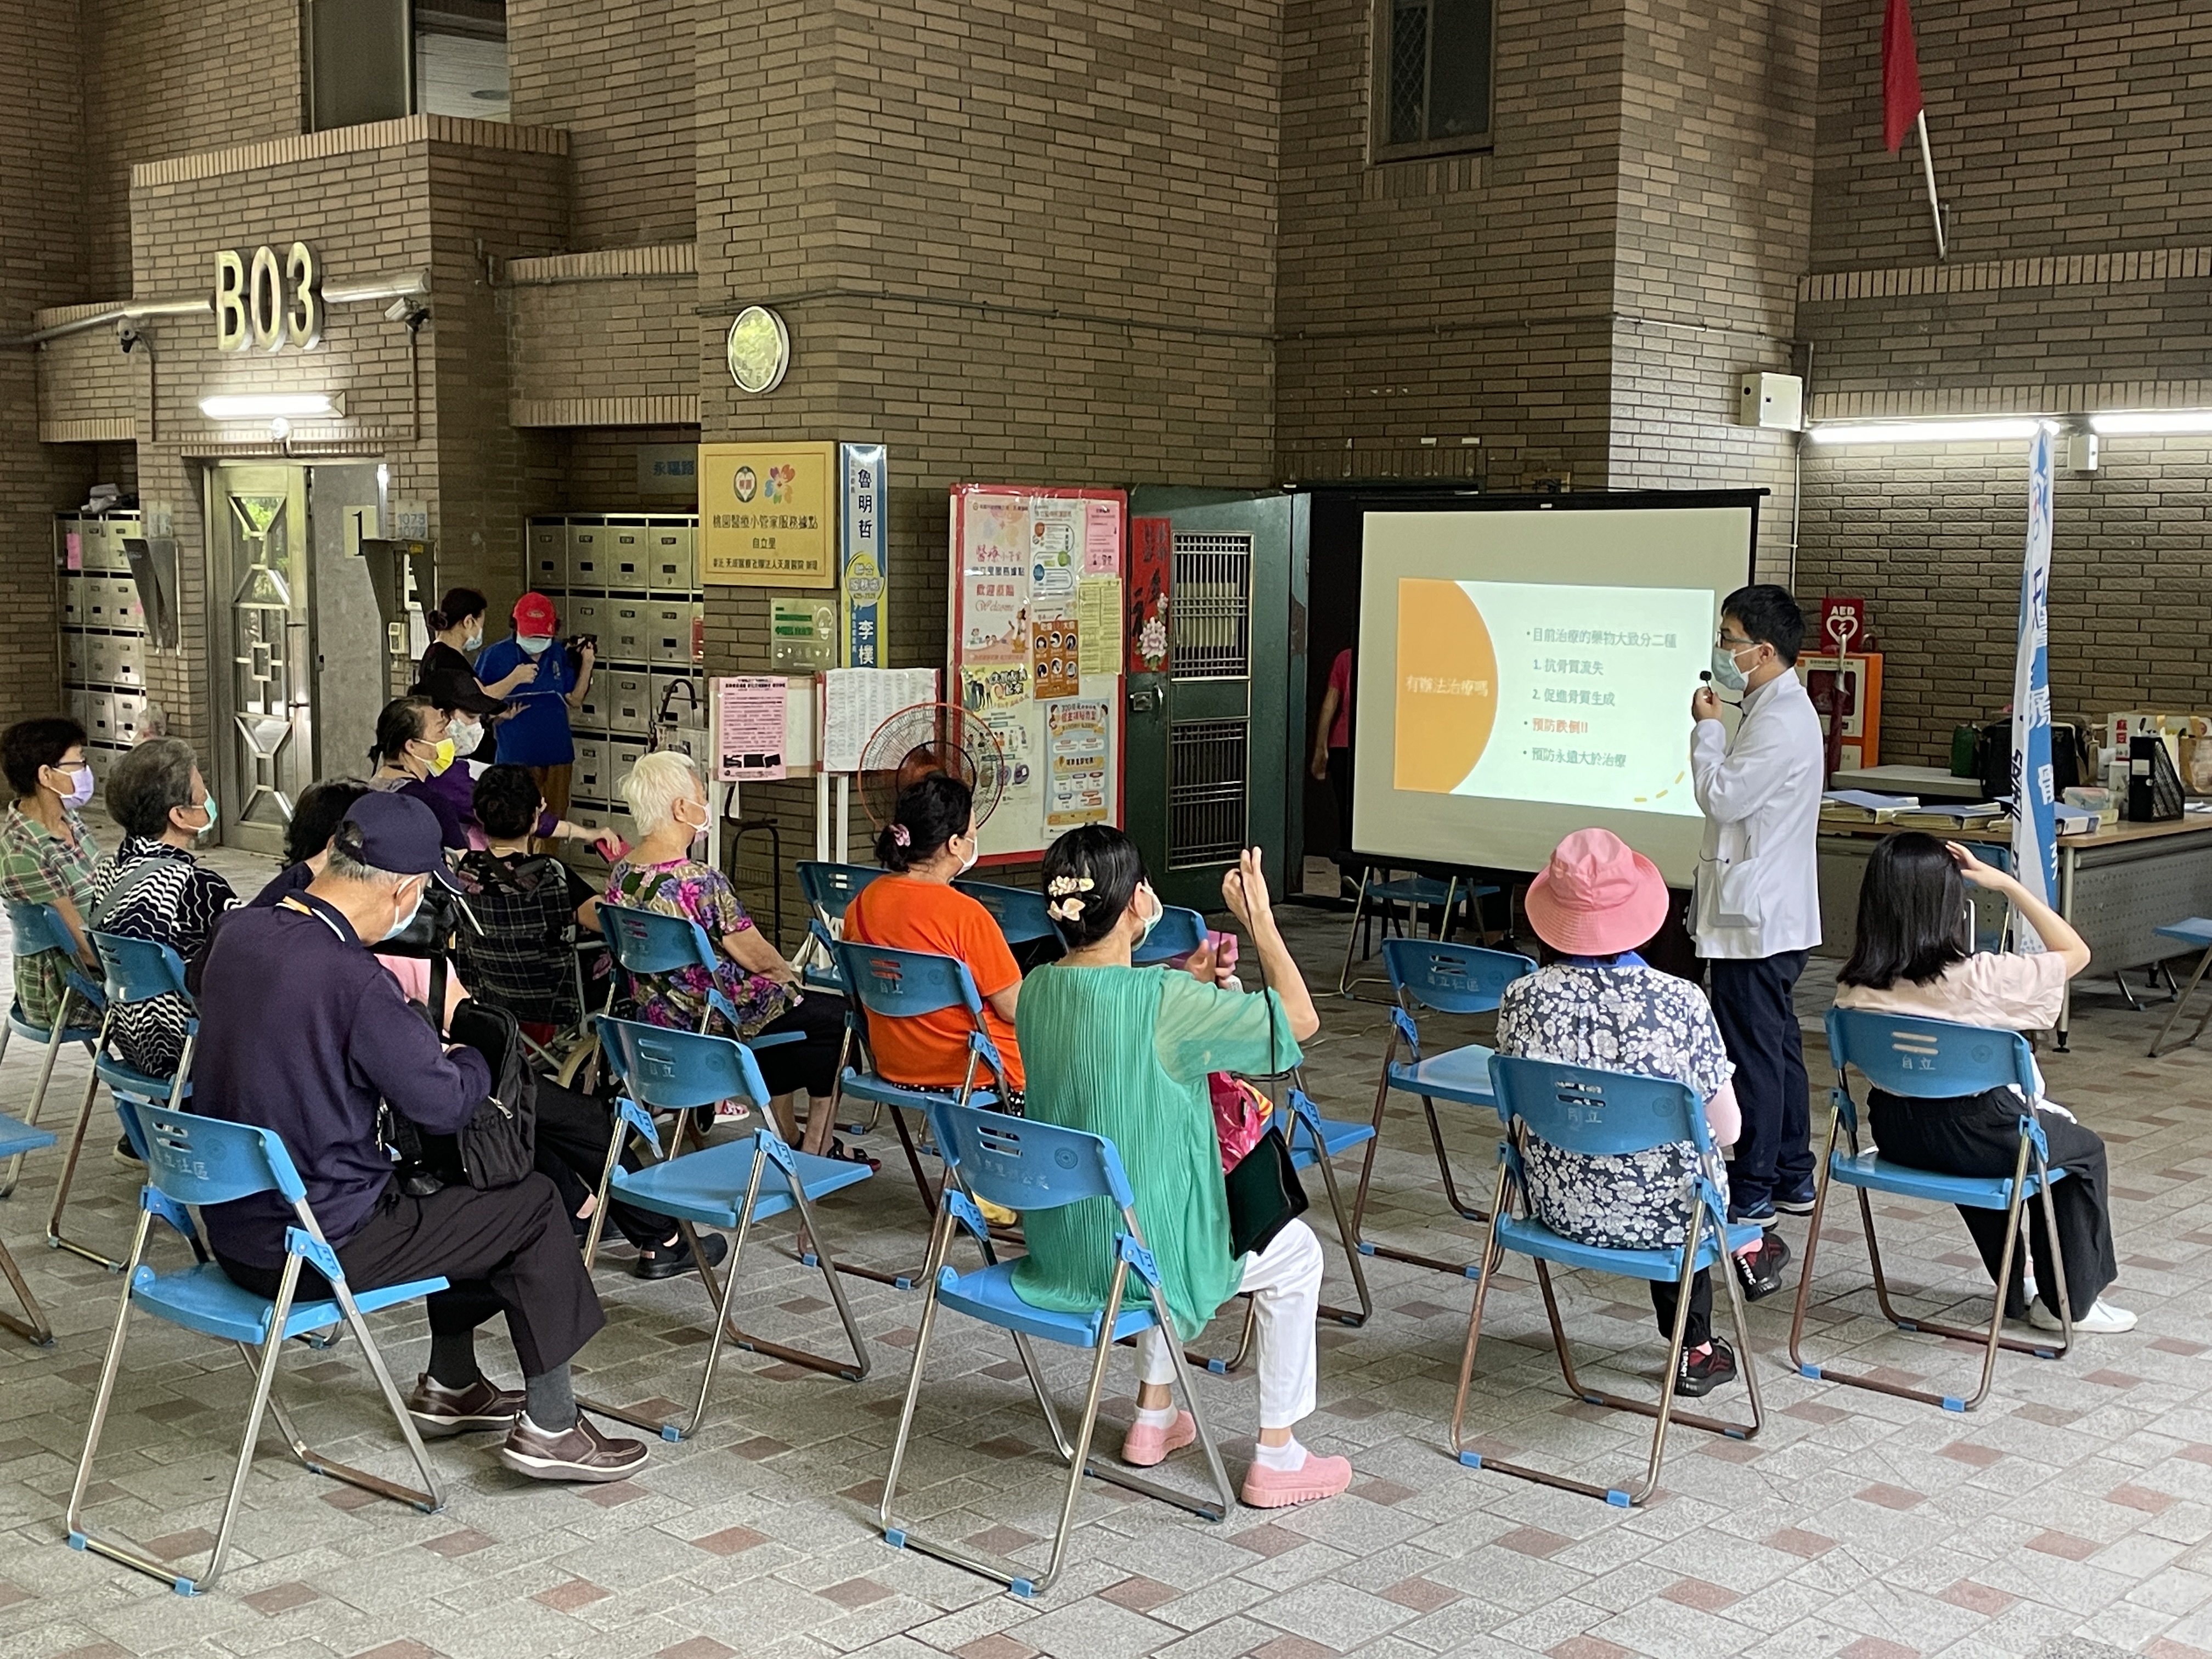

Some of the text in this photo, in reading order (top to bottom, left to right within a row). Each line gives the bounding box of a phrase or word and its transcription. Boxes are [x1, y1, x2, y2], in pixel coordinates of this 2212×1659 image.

[858, 469, 872, 538] 魯明哲
[753, 537, 776, 549] 自立里
[975, 599, 1014, 612] Welcome
[1831, 606, 1855, 616] AED
[1533, 628, 1677, 648] 目前治療的藥物大致分二種
[1545, 658, 1604, 675] 抗骨質流失
[1544, 688, 1615, 707] 促進骨質生成
[1532, 747, 1627, 768] 預防永遠大於治療
[1902, 1054, 1937, 1070] 自立
